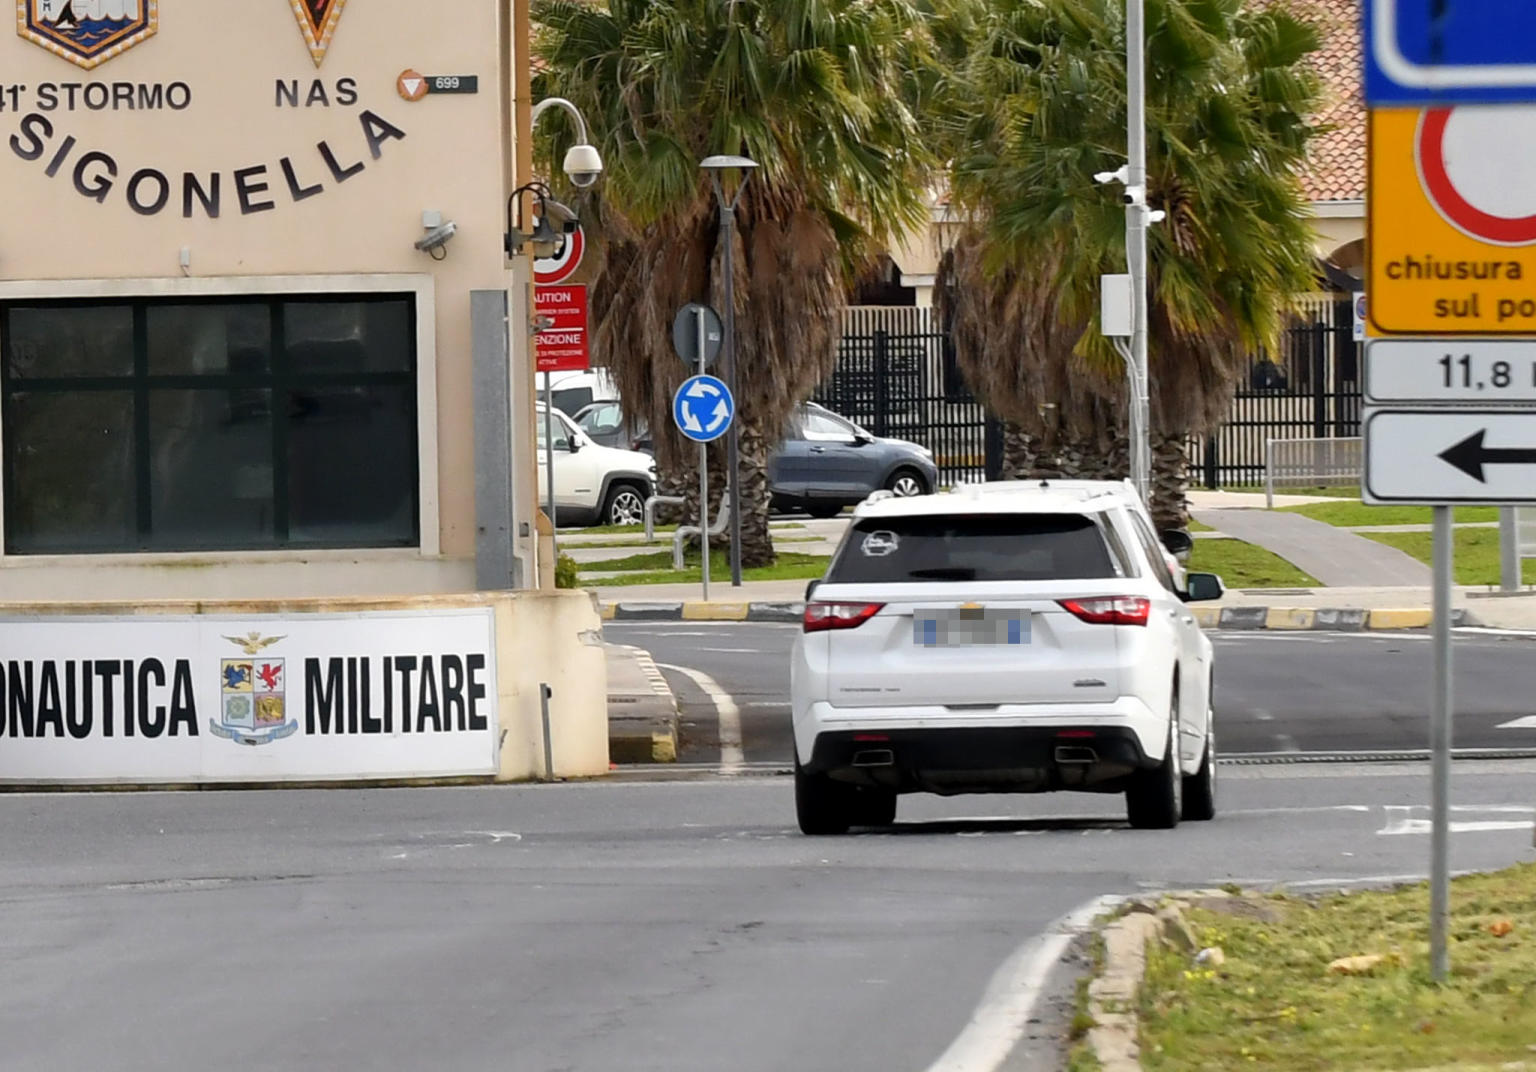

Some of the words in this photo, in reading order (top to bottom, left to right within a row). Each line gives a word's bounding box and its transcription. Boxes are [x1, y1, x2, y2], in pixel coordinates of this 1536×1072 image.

[35, 80, 193, 112] STORMO
[274, 77, 359, 108] NAS
[435, 76, 460, 89] 699
[8, 109, 406, 220] SIGONELLA
[1385, 254, 1523, 281] chiusura
[534, 292, 572, 303] UTION
[1434, 292, 1482, 319] sul
[1438, 353, 1512, 391] 11,8
[304, 653, 488, 735] MILITARE
